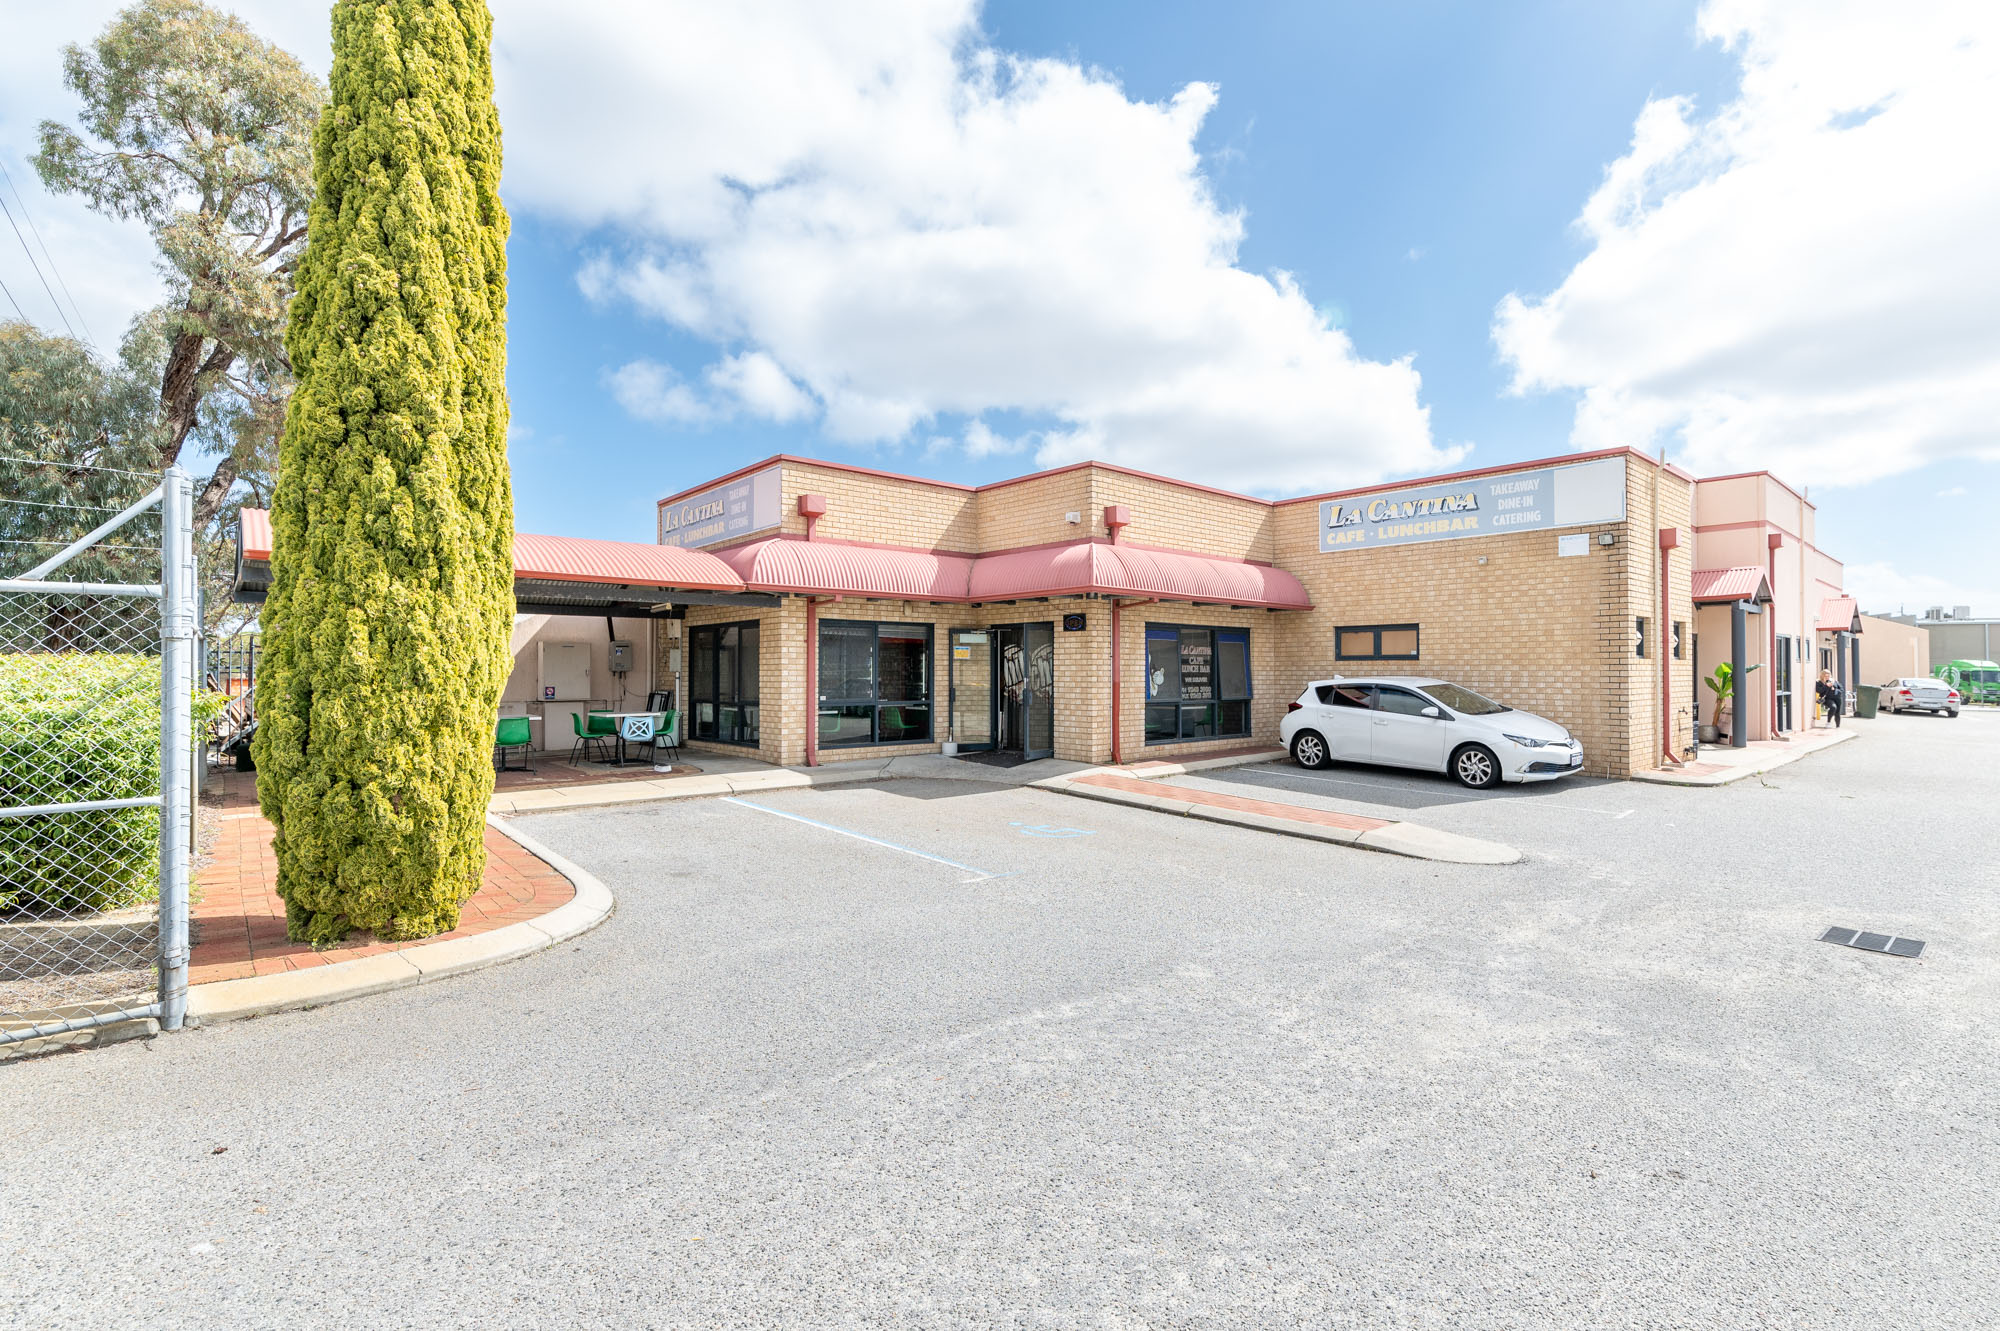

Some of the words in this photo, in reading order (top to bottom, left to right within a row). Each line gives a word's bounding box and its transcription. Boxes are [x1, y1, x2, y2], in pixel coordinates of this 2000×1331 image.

[1490, 478, 1541, 497] TAKEAWAY
[1498, 495, 1534, 510] DINE-IN
[1492, 510, 1542, 526] CATERING
[1327, 529, 1365, 545] CAFE
[1378, 515, 1479, 540] LUNCHBAR
